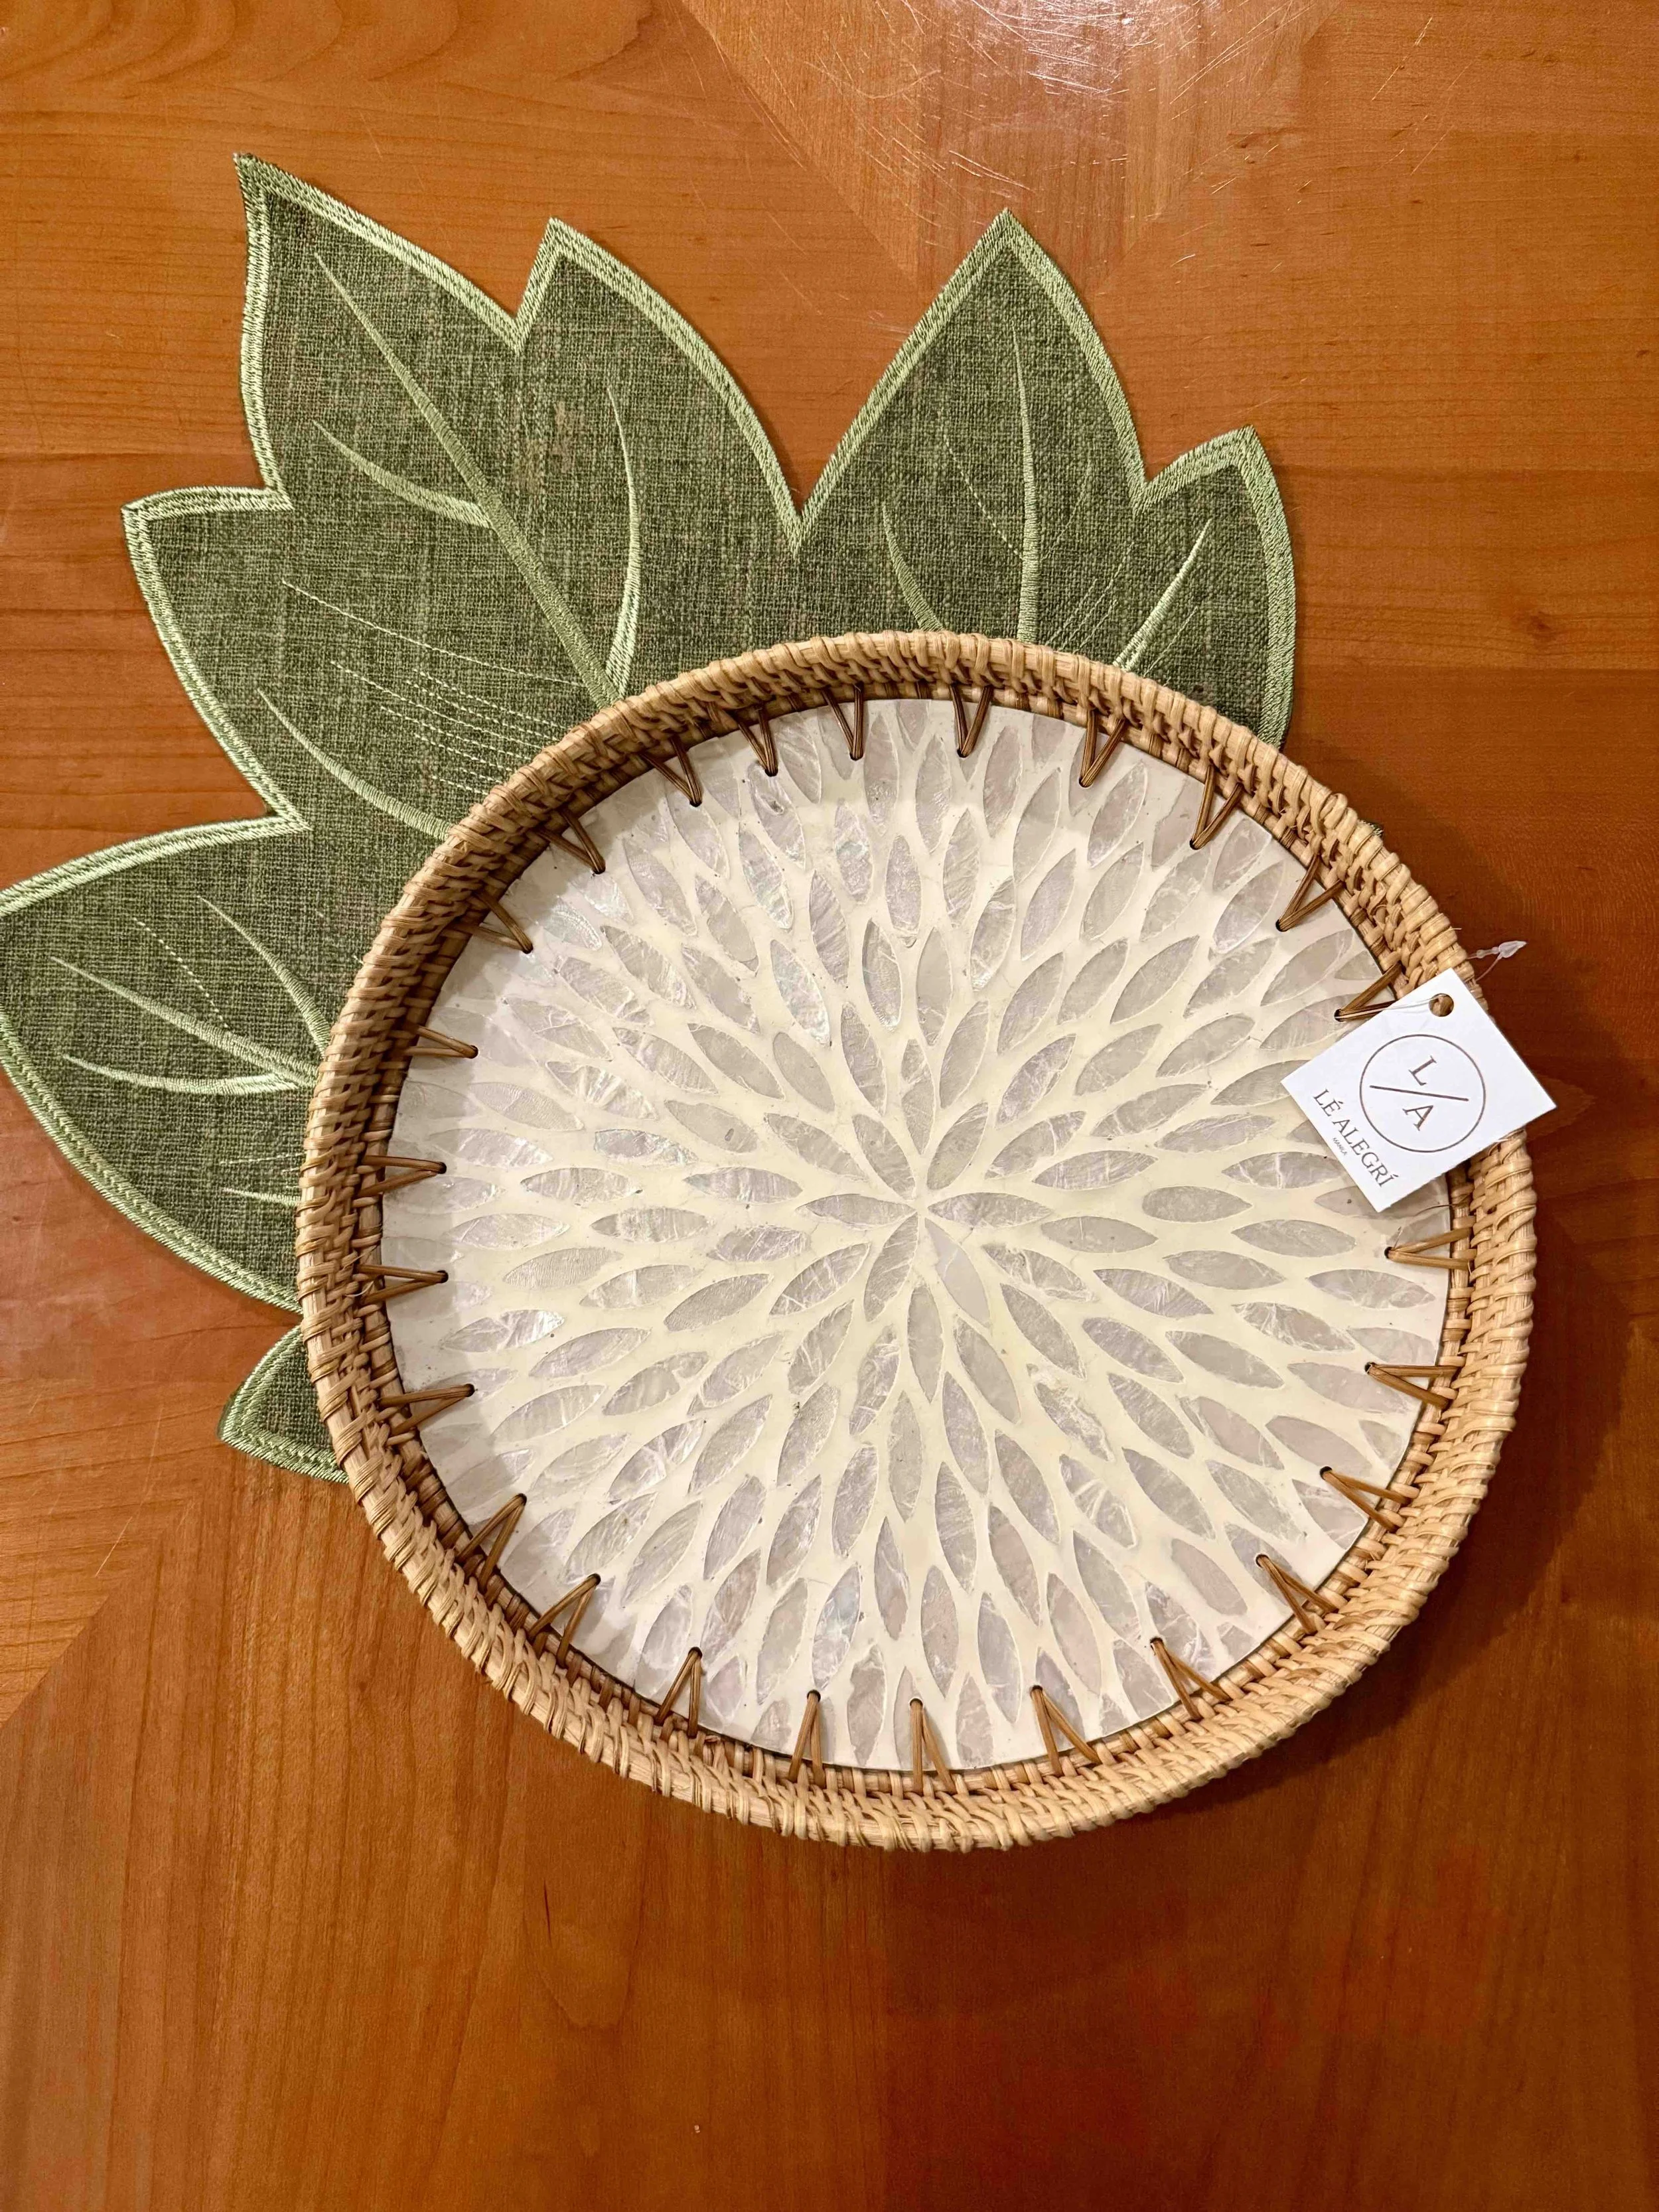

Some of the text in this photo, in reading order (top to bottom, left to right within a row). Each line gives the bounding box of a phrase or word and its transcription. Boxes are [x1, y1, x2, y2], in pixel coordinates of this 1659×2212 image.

[1408, 1055, 1437, 1086] L
[1402, 1104, 1434, 1131] A
[1313, 1088, 1399, 1187] LÉ ALEGRÍ
